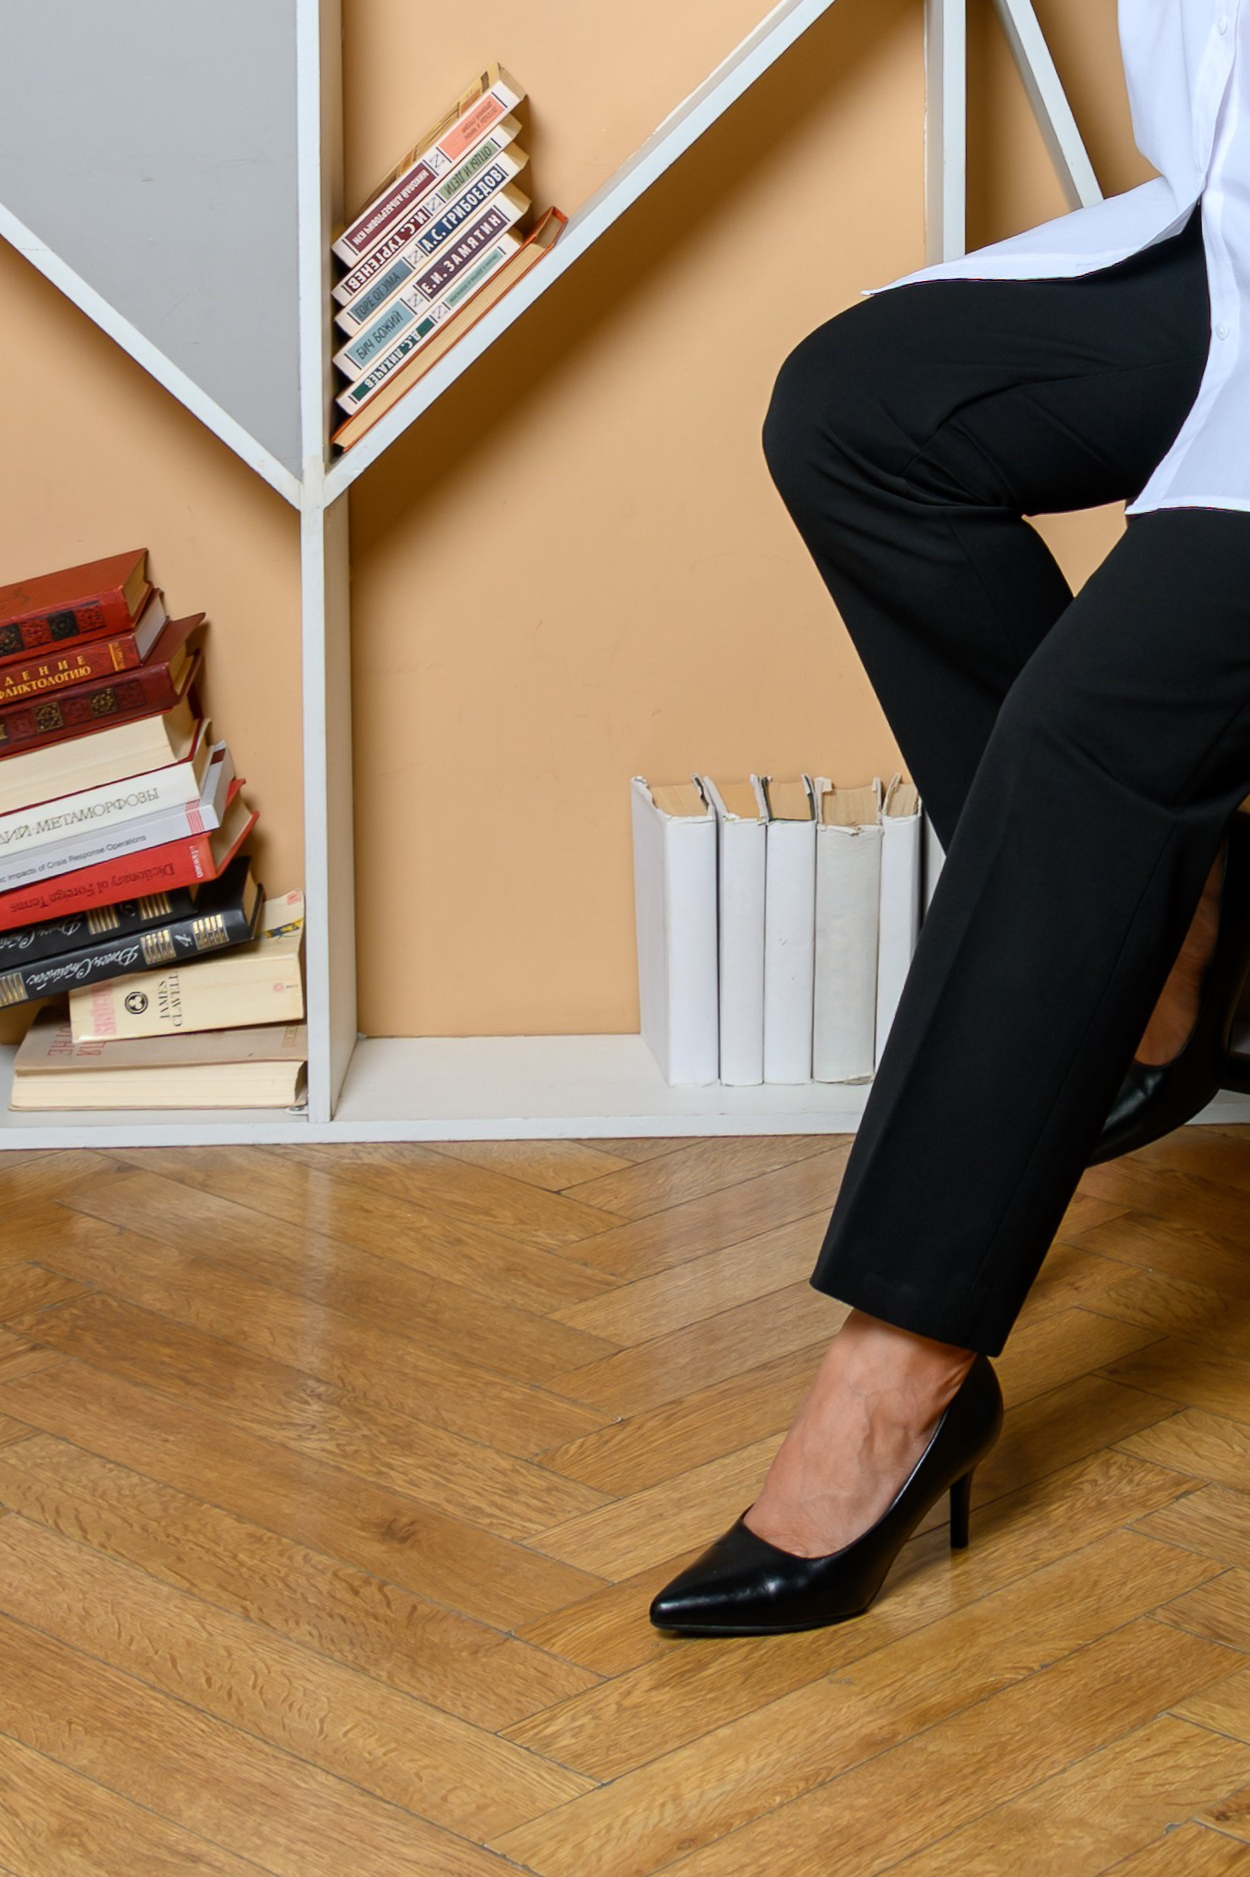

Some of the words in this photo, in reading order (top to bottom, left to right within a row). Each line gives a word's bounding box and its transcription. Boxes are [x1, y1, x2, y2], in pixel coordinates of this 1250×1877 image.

[470, 146, 492, 171] ОТЦЫ
[445, 174, 466, 197] ДЕТИ
[400, 208, 430, 235] И.С.
[421, 228, 448, 252] А.С.
[441, 167, 504, 227] ГРИБОЕДОВ
[347, 235, 406, 290] ТУРГЕНЕВ
[421, 271, 448, 295] Е.И.
[443, 213, 503, 273] ЗАМЯТИН
[355, 298, 376, 319] ГОРЕ
[383, 272, 401, 293] УМА
[355, 338, 375, 360] БИЧ
[372, 310, 404, 345] БОЖИЙ
[401, 330, 422, 352] Д.С.
[34, 788, 160, 835] МЕТАМОРФОЗЫ
[106, 834, 147, 852] Operations
[98, 879, 111, 893] of
[112, 862, 175, 885] Dictionary
[10, 899, 49, 913] Terms
[50, 883, 96, 903] Foreign
[158, 979, 171, 1021] JAMES
[168, 971, 183, 1028] CLAVELL
